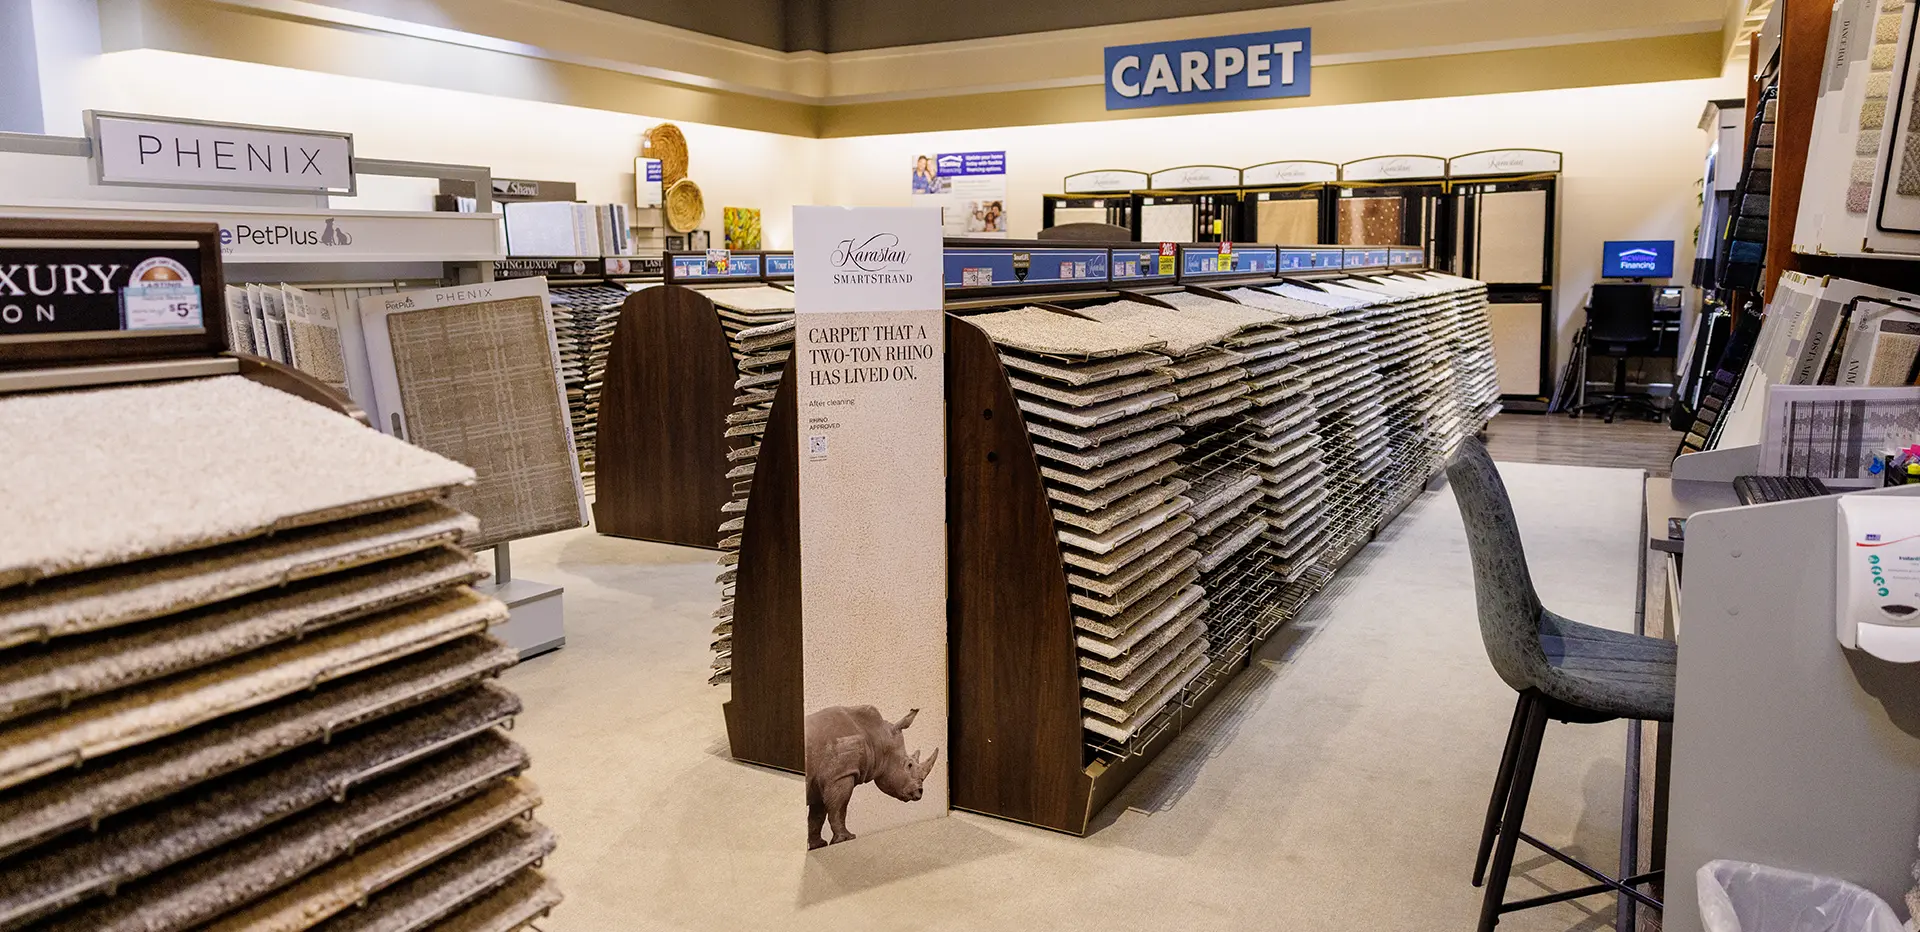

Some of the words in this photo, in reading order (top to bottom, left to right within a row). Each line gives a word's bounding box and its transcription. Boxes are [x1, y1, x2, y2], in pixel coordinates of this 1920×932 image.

[1111, 41, 1302, 98] CARPET
[138, 134, 322, 175] PHENIX
[510, 181, 537, 196] Shaw
[237, 225, 318, 245] PetPlus
[830, 233, 911, 271] Karastan
[524, 260, 558, 269] LUXURY
[1620, 261, 1656, 270] Financing
[834, 274, 913, 284] SMARTSTRAND
[436, 288, 493, 303] PHENIX
[809, 326, 869, 343] CARPET
[873, 325, 913, 340] THAT
[916, 325, 927, 339] A
[809, 346, 881, 364] TWO-TON
[886, 345, 933, 361] RHINO
[810, 369, 840, 385] HAS
[844, 367, 889, 383] LIVED
[892, 366, 917, 382] ON.
[809, 400, 825, 408] After
[827, 399, 855, 407] cleaning
